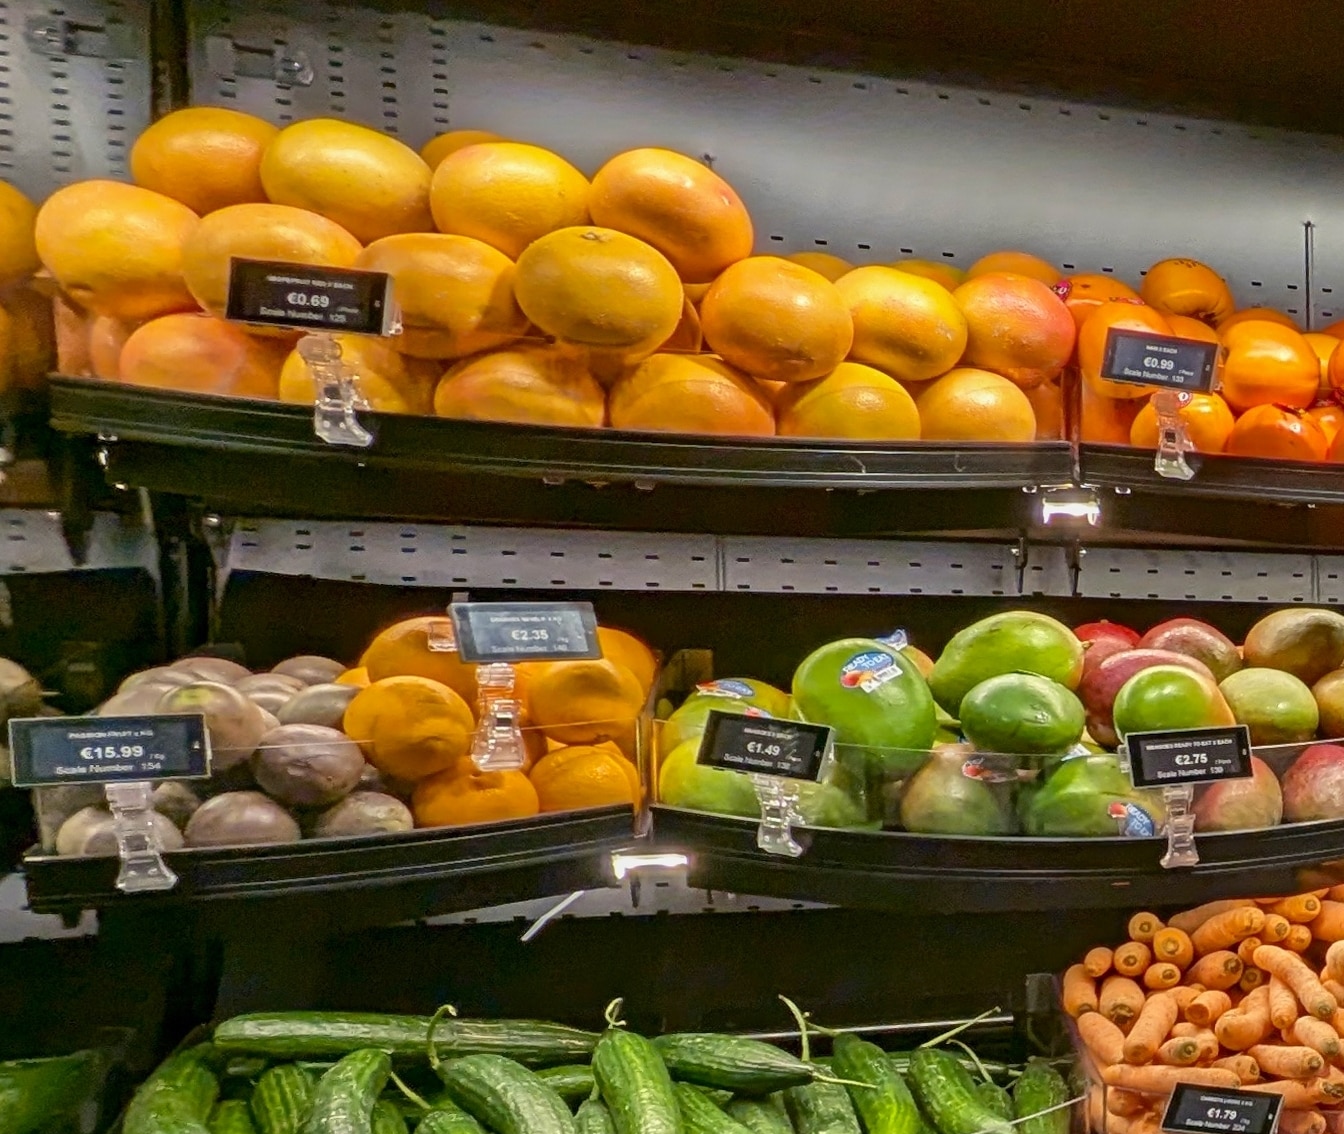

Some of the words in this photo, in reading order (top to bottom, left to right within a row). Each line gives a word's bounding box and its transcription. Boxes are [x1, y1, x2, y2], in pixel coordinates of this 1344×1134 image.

[287, 292, 330, 308] €0.69
[1144, 357, 1174, 371] €0.99
[1143, 370, 1169, 382] Number
[513, 630, 549, 642] €2.35
[843, 654, 870, 672] READY
[863, 660, 874, 669] TO
[875, 653, 890, 665] EAT
[81, 745, 144, 760] €15.99
[747, 742, 781, 756] €1.49
[1175, 754, 1207, 766] €2.75
[91, 763, 134, 775] Number
[1157, 771, 1177, 780] Scale
[1178, 769, 1206, 779] Number
[1127, 803, 1150, 825] READY
[1207, 1108, 1237, 1120] €1.79
